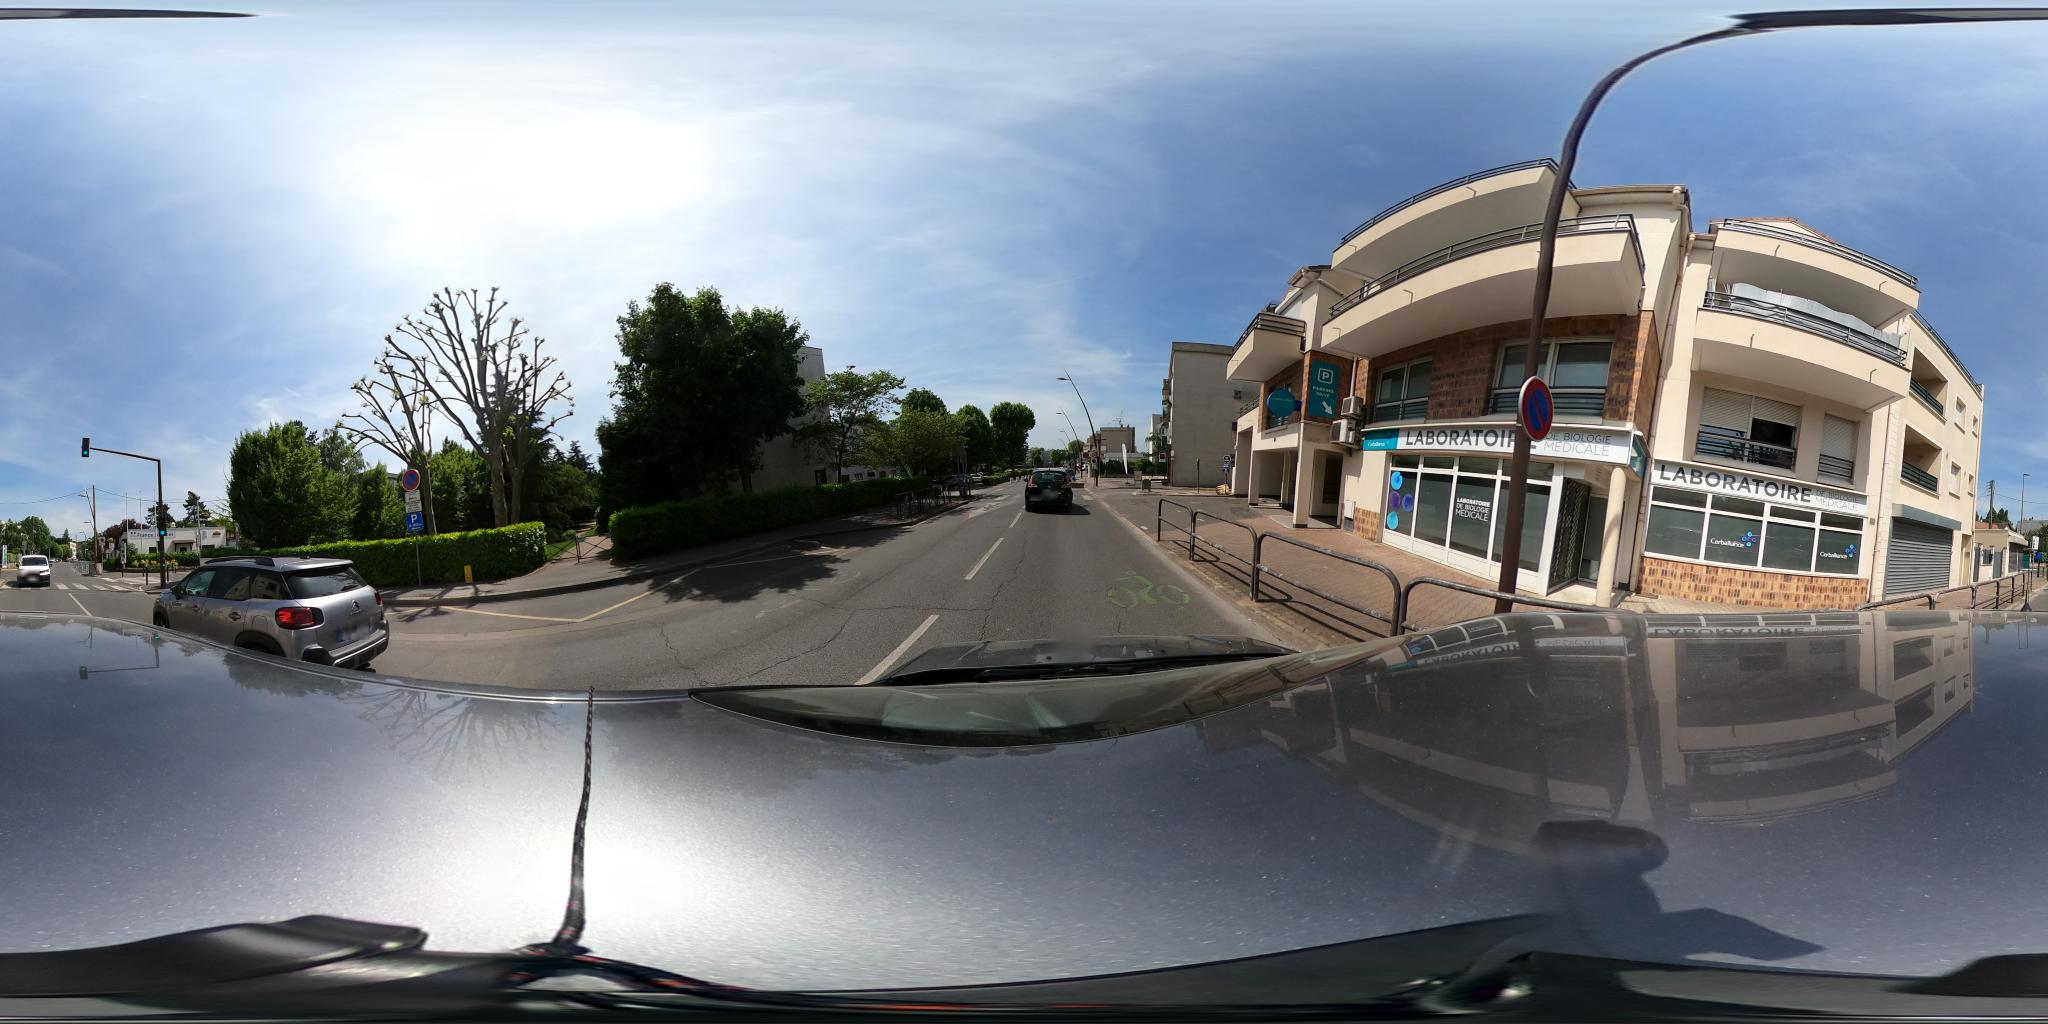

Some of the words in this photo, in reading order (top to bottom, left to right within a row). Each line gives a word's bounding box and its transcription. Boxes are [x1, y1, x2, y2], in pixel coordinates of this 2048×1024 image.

[1322, 371, 1329, 380] P
[1563, 432, 1612, 445] BIOLOGIE
[1659, 464, 1812, 503] LABORATOIRE
[1456, 497, 1490, 508] LABORATOIRE
[1464, 504, 1490, 514] BIOLOGIE
[411, 514, 418, 524] P
